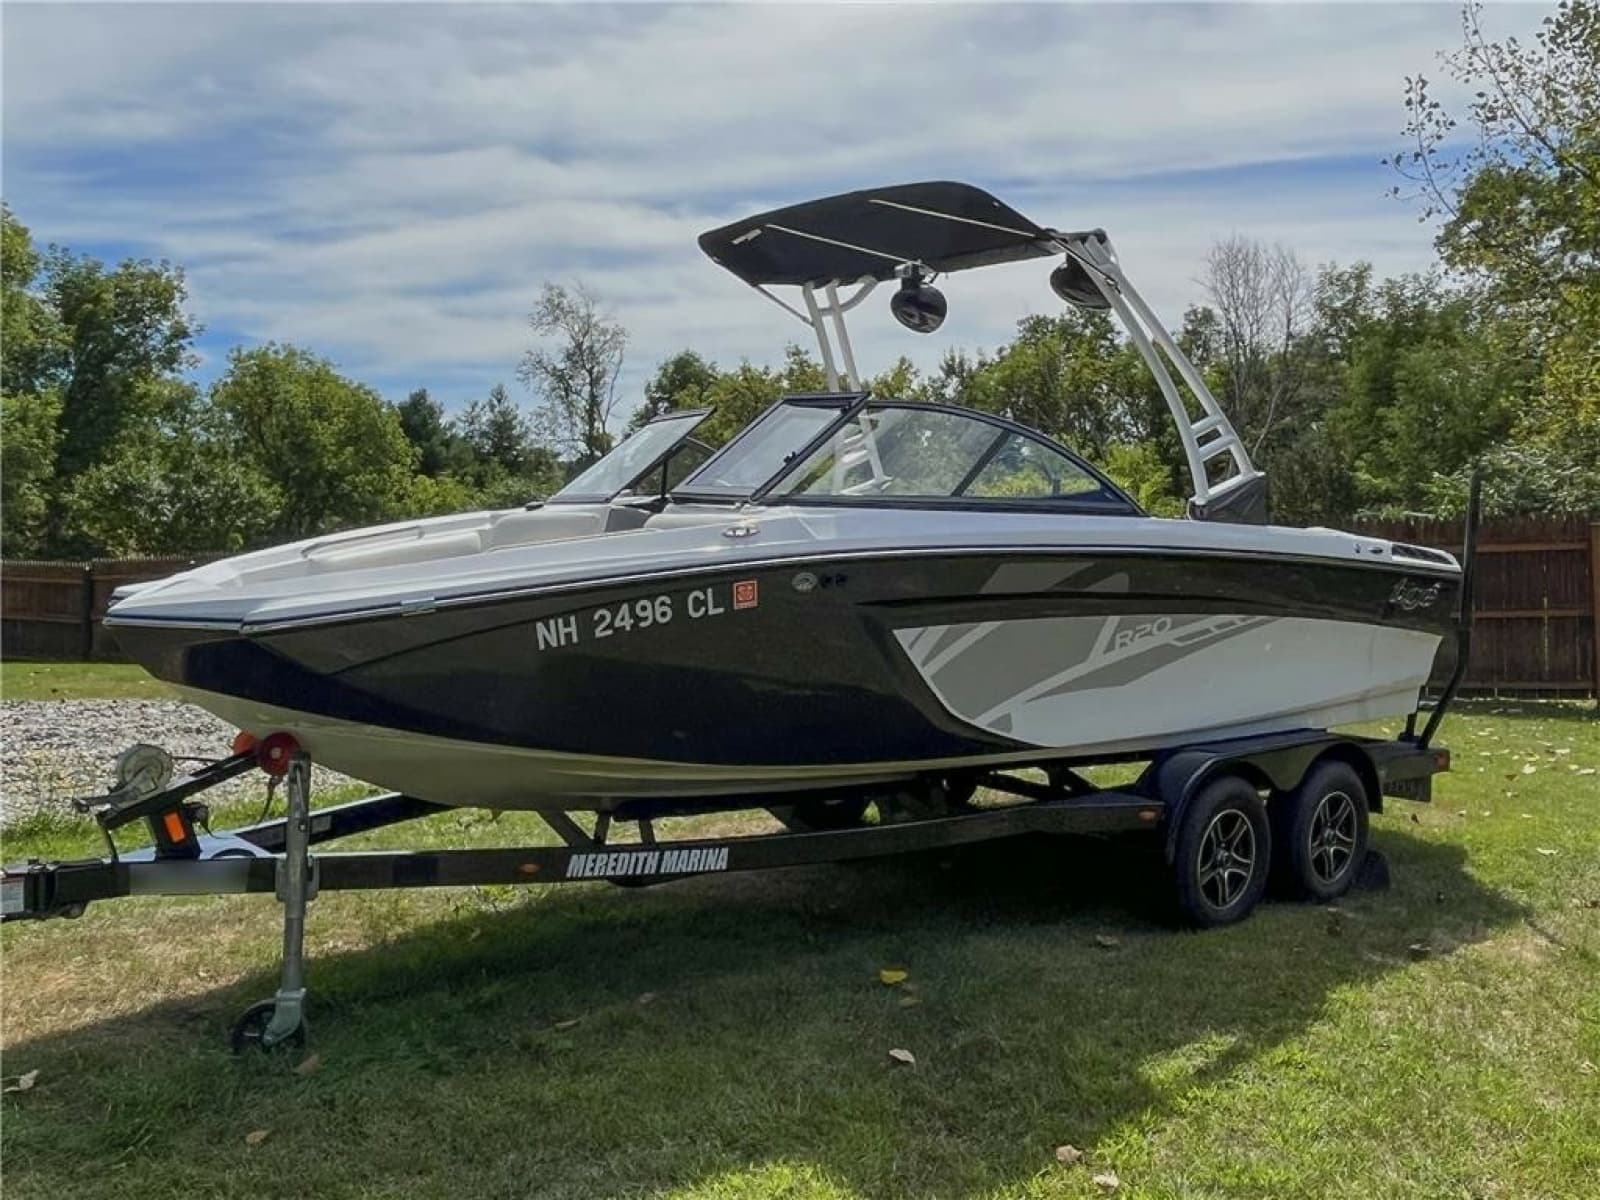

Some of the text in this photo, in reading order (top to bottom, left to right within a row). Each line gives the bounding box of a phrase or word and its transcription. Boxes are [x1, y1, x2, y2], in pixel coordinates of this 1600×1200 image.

[535, 615, 578, 650] NH
[593, 596, 673, 639] 2496
[687, 587, 725, 618] CL
[566, 847, 729, 877] MEREDITH MARINA
